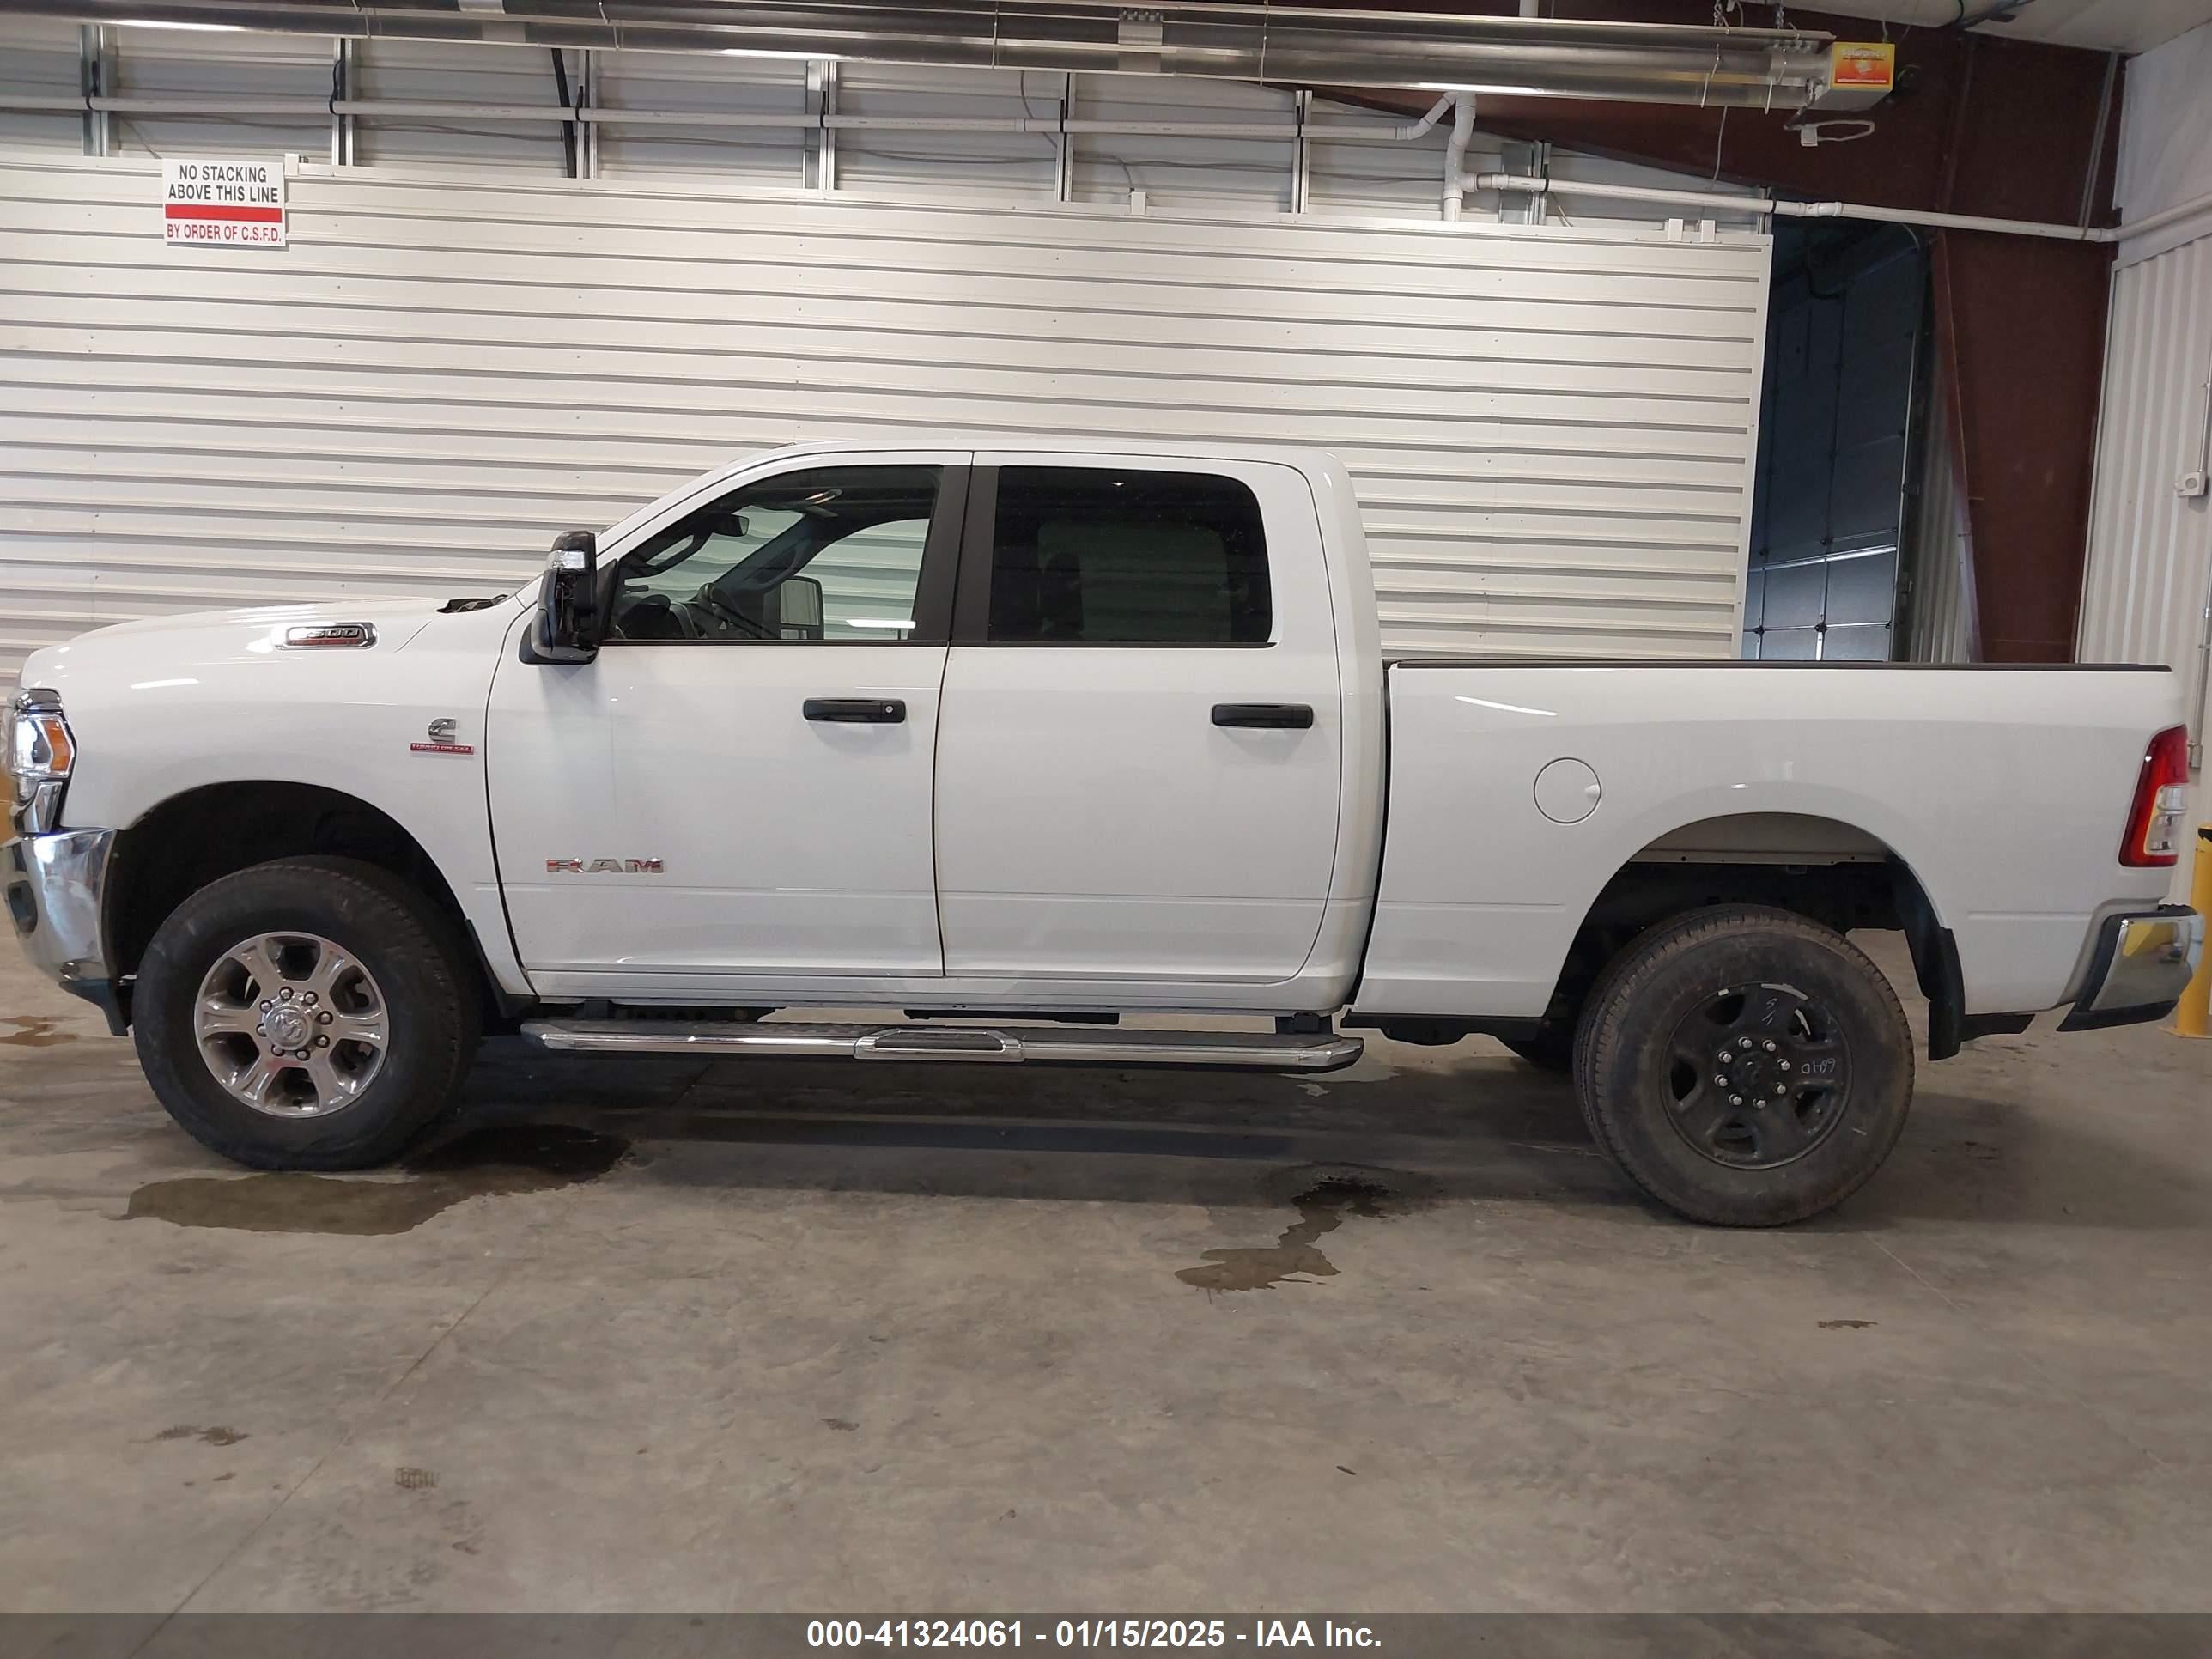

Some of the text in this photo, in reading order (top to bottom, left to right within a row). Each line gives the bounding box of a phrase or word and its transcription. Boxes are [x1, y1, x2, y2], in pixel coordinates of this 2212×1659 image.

[179, 165, 267, 183] NO STACKING
[168, 184, 278, 203] ABOVE THIS LINE
[167, 224, 282, 242] BY ORDER OF C.S.F.D.
[546, 857, 664, 873] RAM
